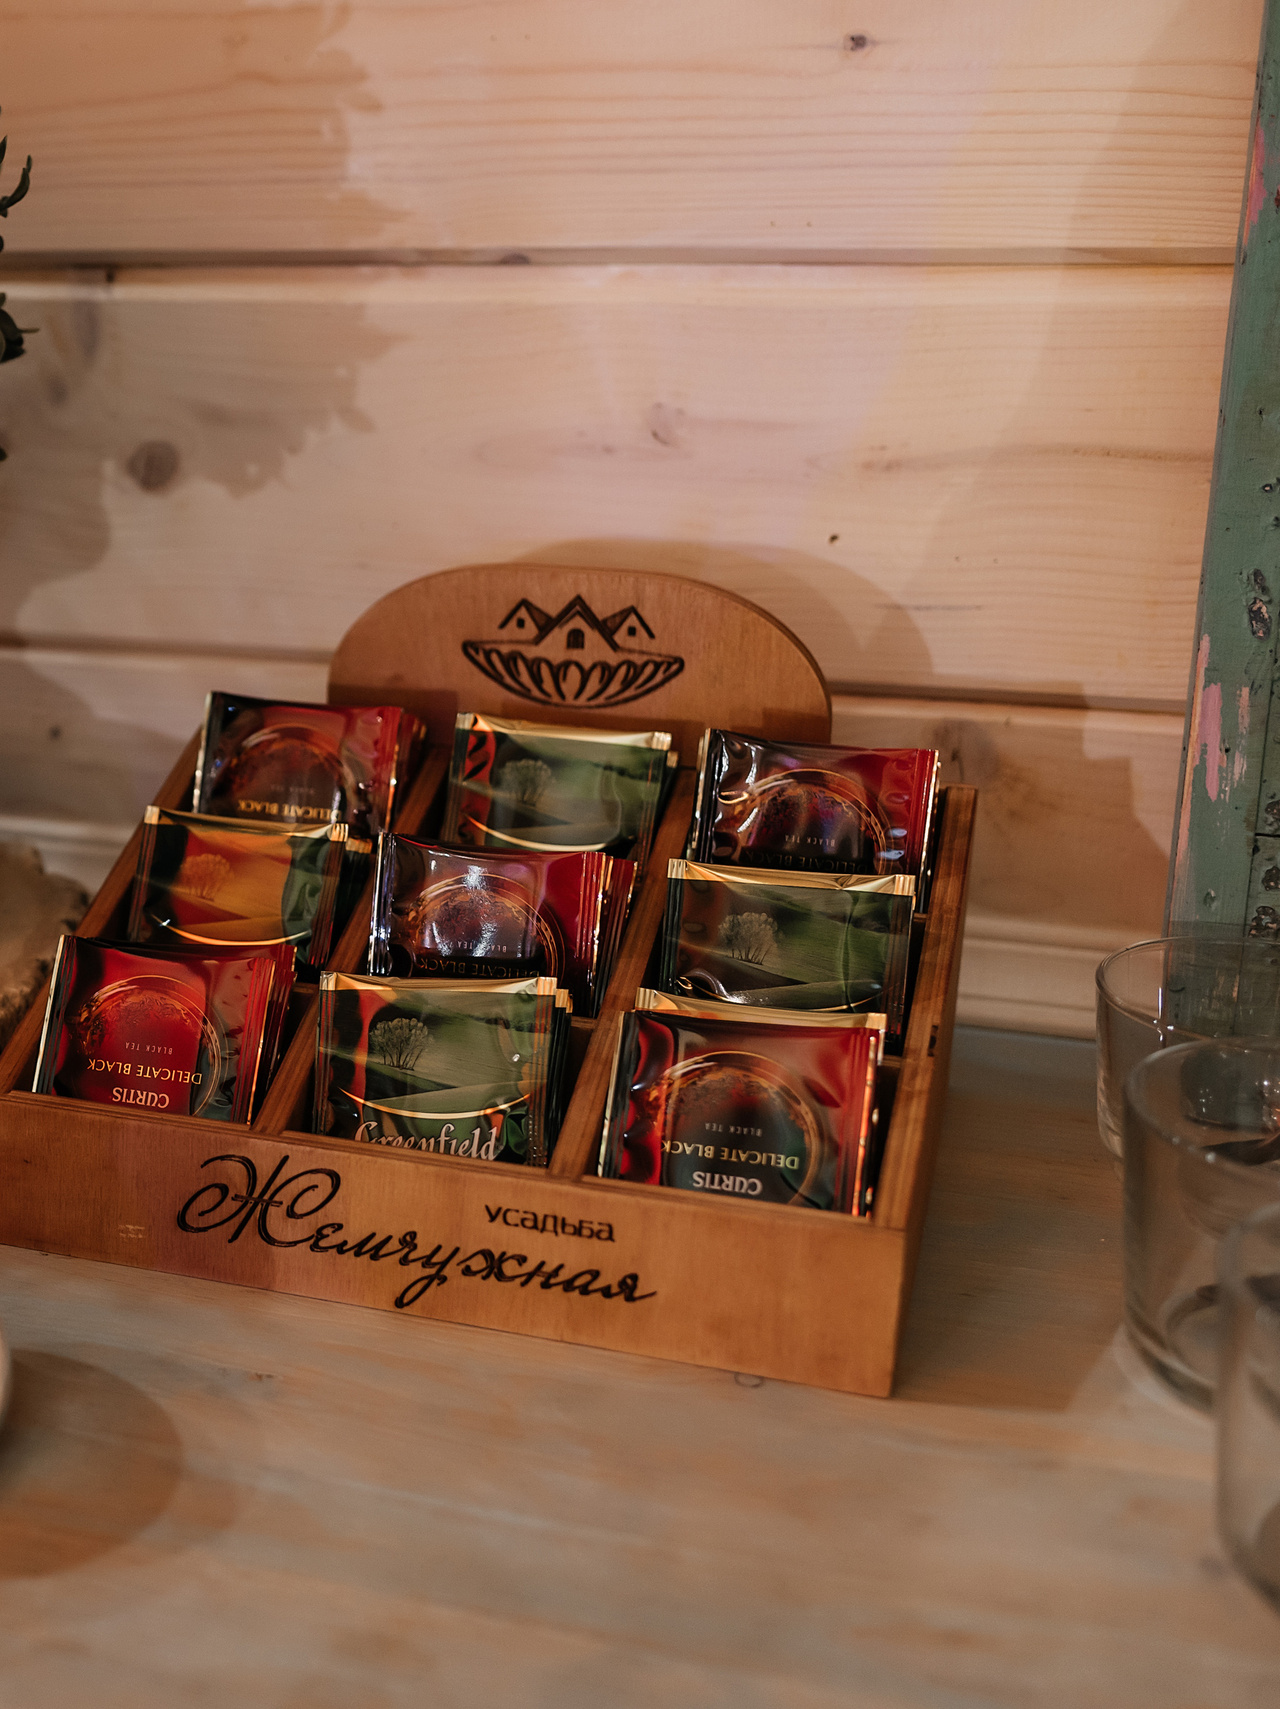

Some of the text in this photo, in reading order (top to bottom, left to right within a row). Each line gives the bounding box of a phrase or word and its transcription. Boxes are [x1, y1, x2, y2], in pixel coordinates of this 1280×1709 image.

[420, 959, 466, 974] BLACK
[125, 1042, 173, 1055] BLACK TEA
[87, 1058, 203, 1084] DELICATE BLACK
[113, 1086, 170, 1108] CURTIS
[705, 1123, 762, 1137] BLACK TEA
[662, 1141, 799, 1170] DELICATE BLACK
[692, 1171, 762, 1195] CURTIS
[176, 1153, 657, 1308] Жемчужная
